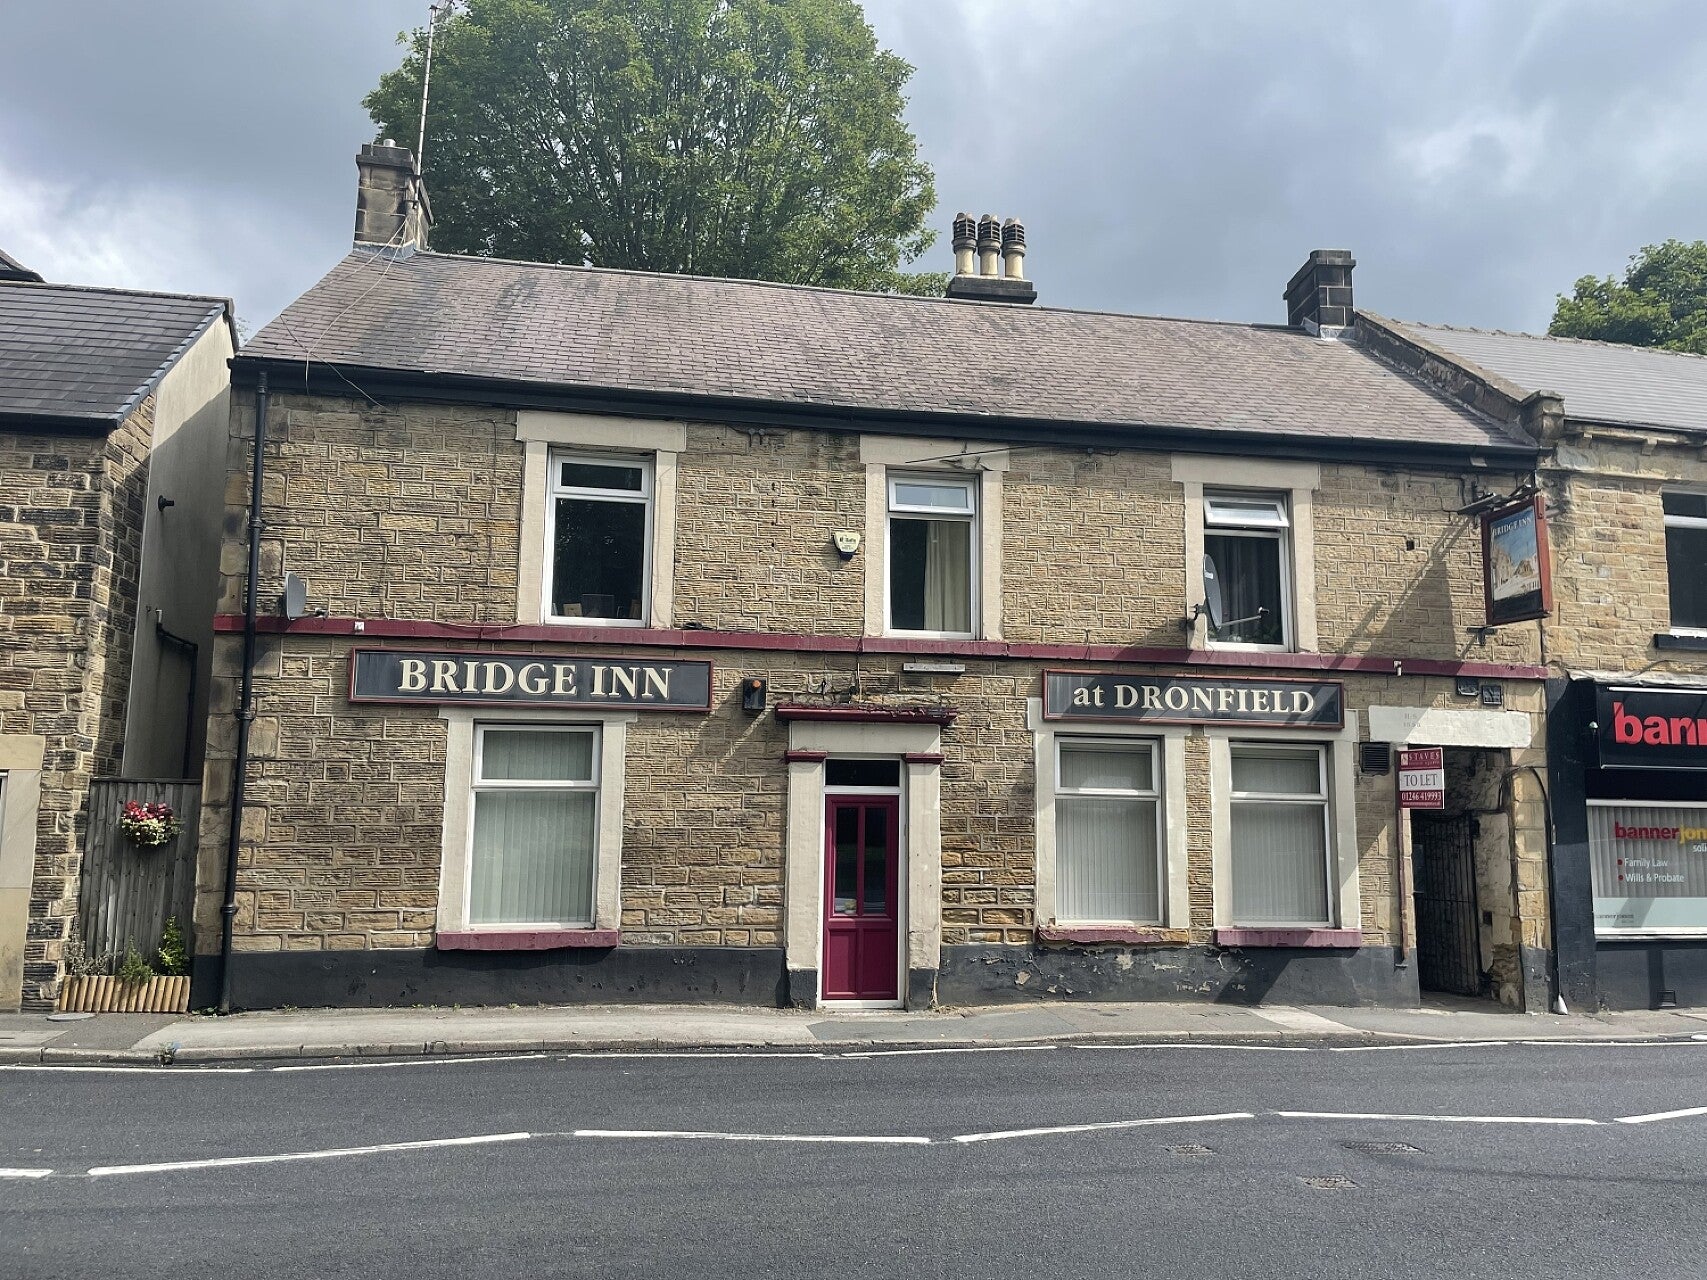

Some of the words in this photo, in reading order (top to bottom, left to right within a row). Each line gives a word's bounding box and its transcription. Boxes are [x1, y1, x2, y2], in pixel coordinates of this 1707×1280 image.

[398, 659, 578, 695] BRIDGE
[590, 666, 675, 698] INN
[1073, 686, 1105, 706] at
[1114, 684, 1316, 713] DRONFIELD
[1409, 752, 1440, 761] STAVES
[1404, 775, 1418, 786] TO
[1420, 774, 1438, 786] LET
[1624, 857, 1650, 869] Family
[1652, 858, 1669, 867] Law
[1625, 873, 1644, 883] Wills
[1646, 873, 1652, 883] &
[1654, 873, 1685, 883] Probate
